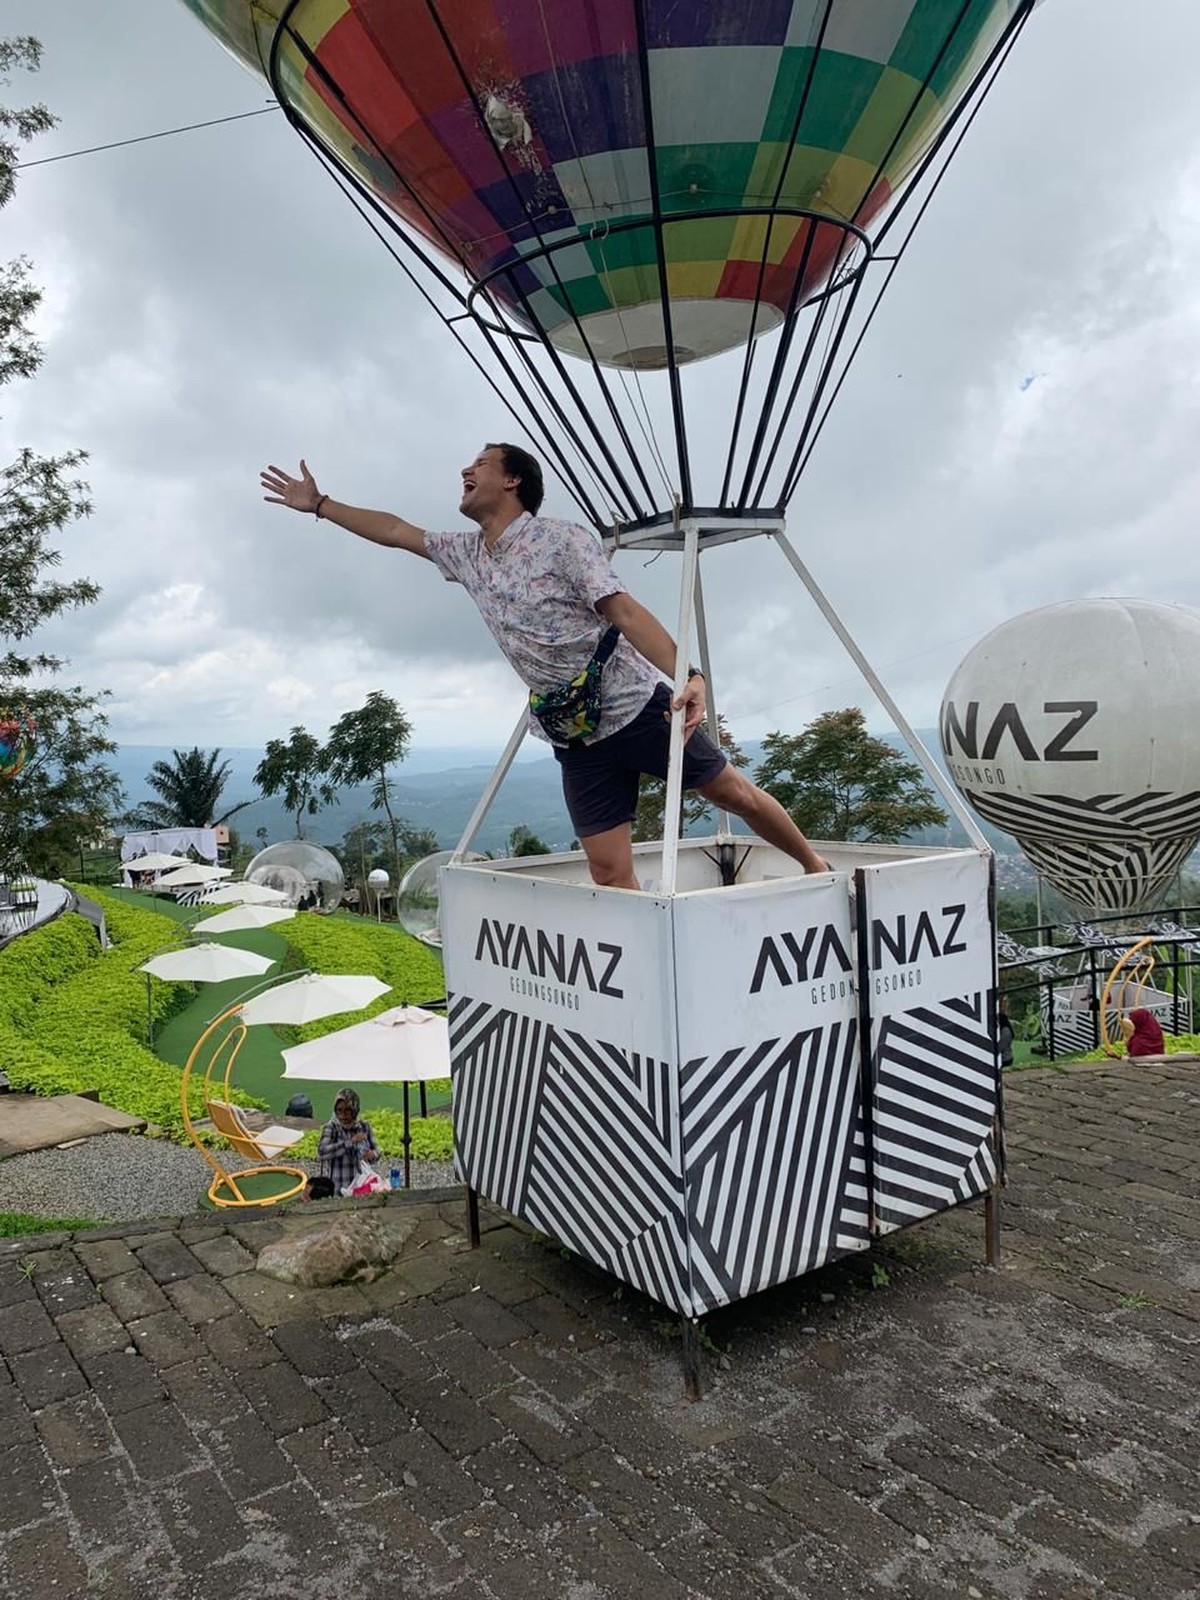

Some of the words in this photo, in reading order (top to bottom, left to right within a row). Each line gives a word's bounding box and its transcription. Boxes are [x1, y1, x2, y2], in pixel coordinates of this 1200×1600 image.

[940, 700, 1099, 761] NAZ
[475, 918, 624, 999] AYANAZ
[510, 976, 580, 1011] GEDONGSONGO
